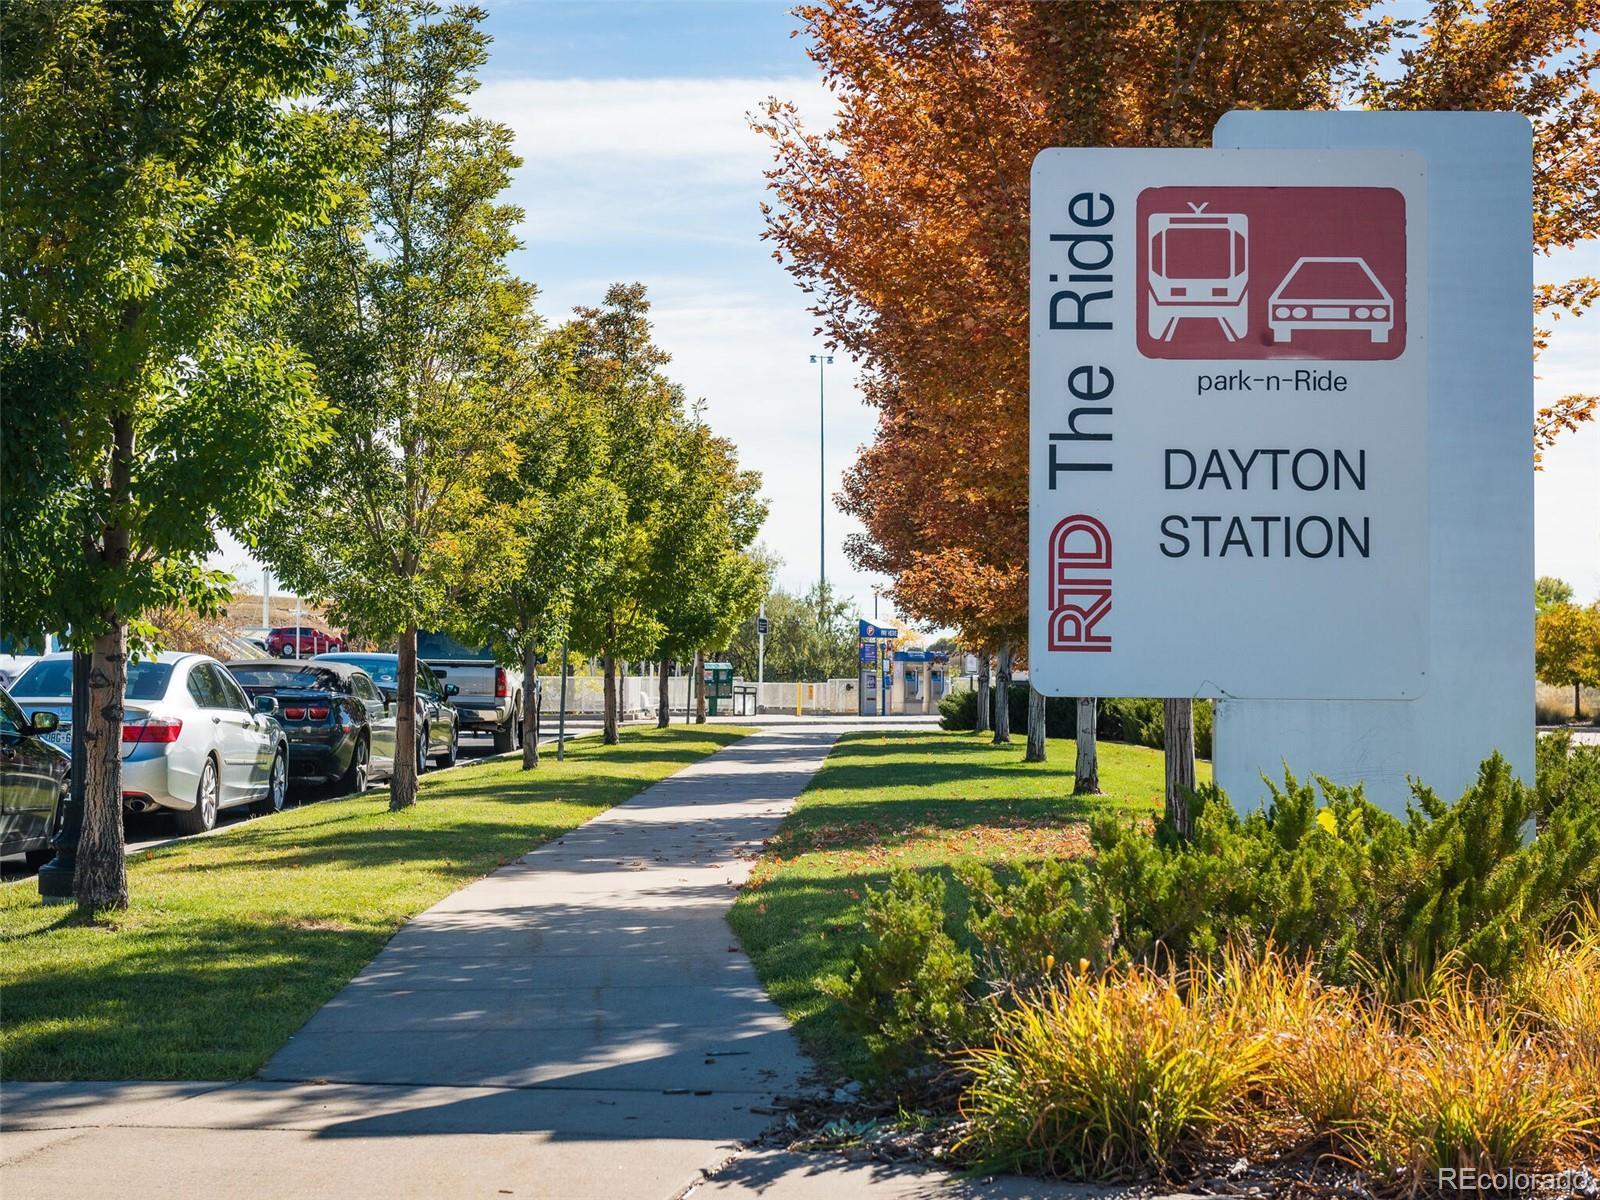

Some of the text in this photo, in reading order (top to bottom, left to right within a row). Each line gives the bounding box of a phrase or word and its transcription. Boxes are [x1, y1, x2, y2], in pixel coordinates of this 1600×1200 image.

[1197, 369, 1348, 396] park-n-Ride
[1048, 192, 1115, 652] RTD The Ride
[1164, 448, 1366, 492] DAYTON
[1159, 514, 1370, 559] STATION
